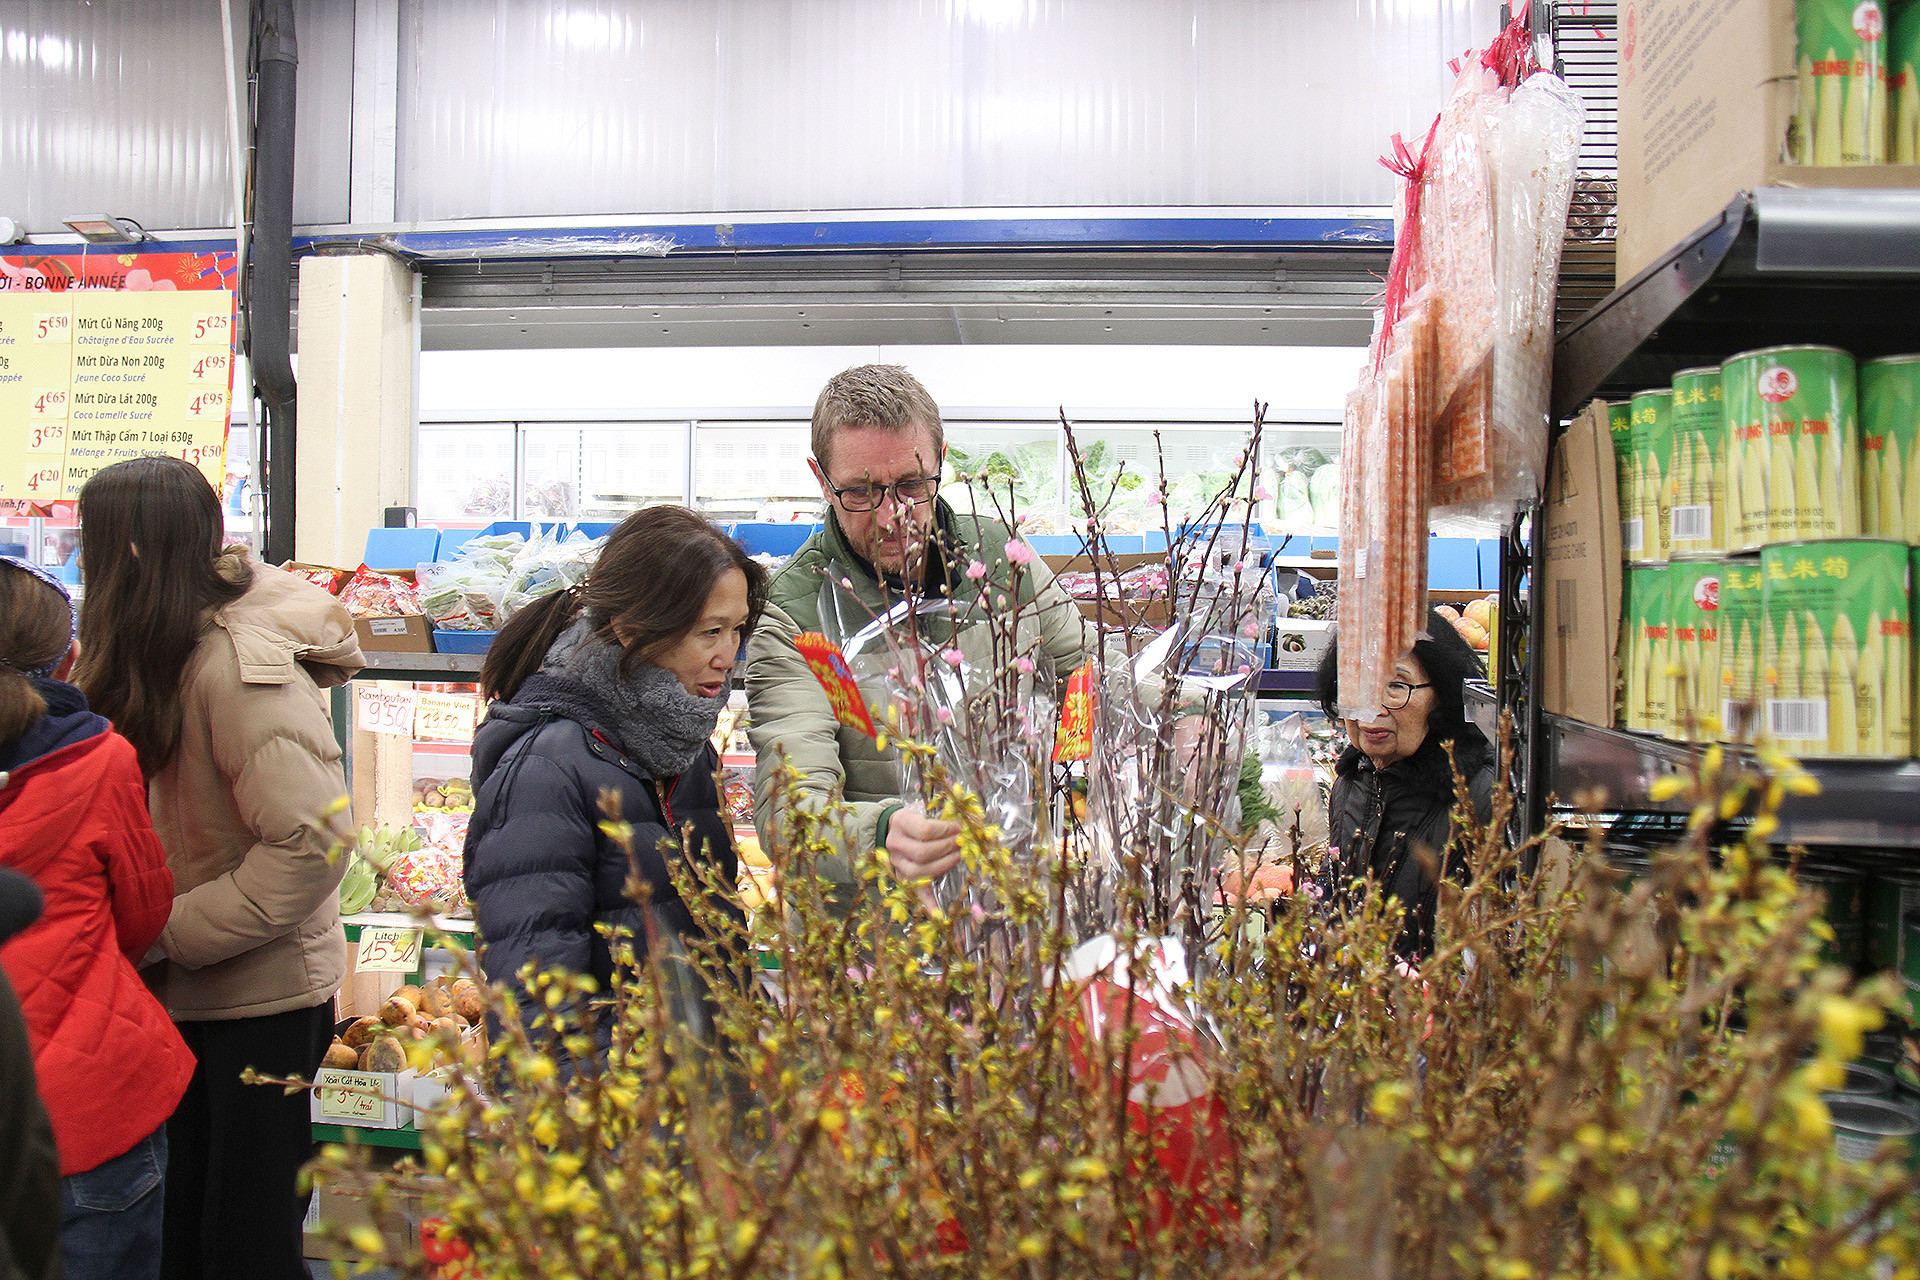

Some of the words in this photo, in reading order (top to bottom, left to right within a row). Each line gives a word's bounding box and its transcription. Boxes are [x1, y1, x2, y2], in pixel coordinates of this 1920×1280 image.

[25, 276, 75, 290] BONNE
[77, 272, 126, 290] ANNÉE
[37, 316, 68, 339] 5€50
[141, 318, 163, 331] 200g
[195, 316, 227, 339] 5€25
[146, 336, 174, 345] Sucrée
[121, 356, 140, 366] Non
[143, 356, 165, 369] 200g
[192, 356, 225, 378] 4€95
[75, 373, 99, 384] Jeune
[101, 373, 120, 382] Coco
[123, 373, 146, 382] Sucré
[34, 391, 66, 413] 4€65
[119, 393, 133, 404] Lát
[136, 393, 157, 407] 200g
[190, 393, 223, 415] 4€95
[73, 411, 93, 420] Coco
[129, 410, 152, 420] Sucré
[1802, 420, 1829, 435] CORN
[32, 426, 63, 448] 3€75
[142, 431, 146, 441] 7
[171, 431, 193, 445] 630g
[107, 448, 112, 456] 7
[114, 448, 138, 457] Fruits
[28, 470, 59, 491] 4€20
[358, 687, 412, 707] Ramboutan
[421, 697, 451, 708] Banane
[453, 701, 470, 711] Viet
